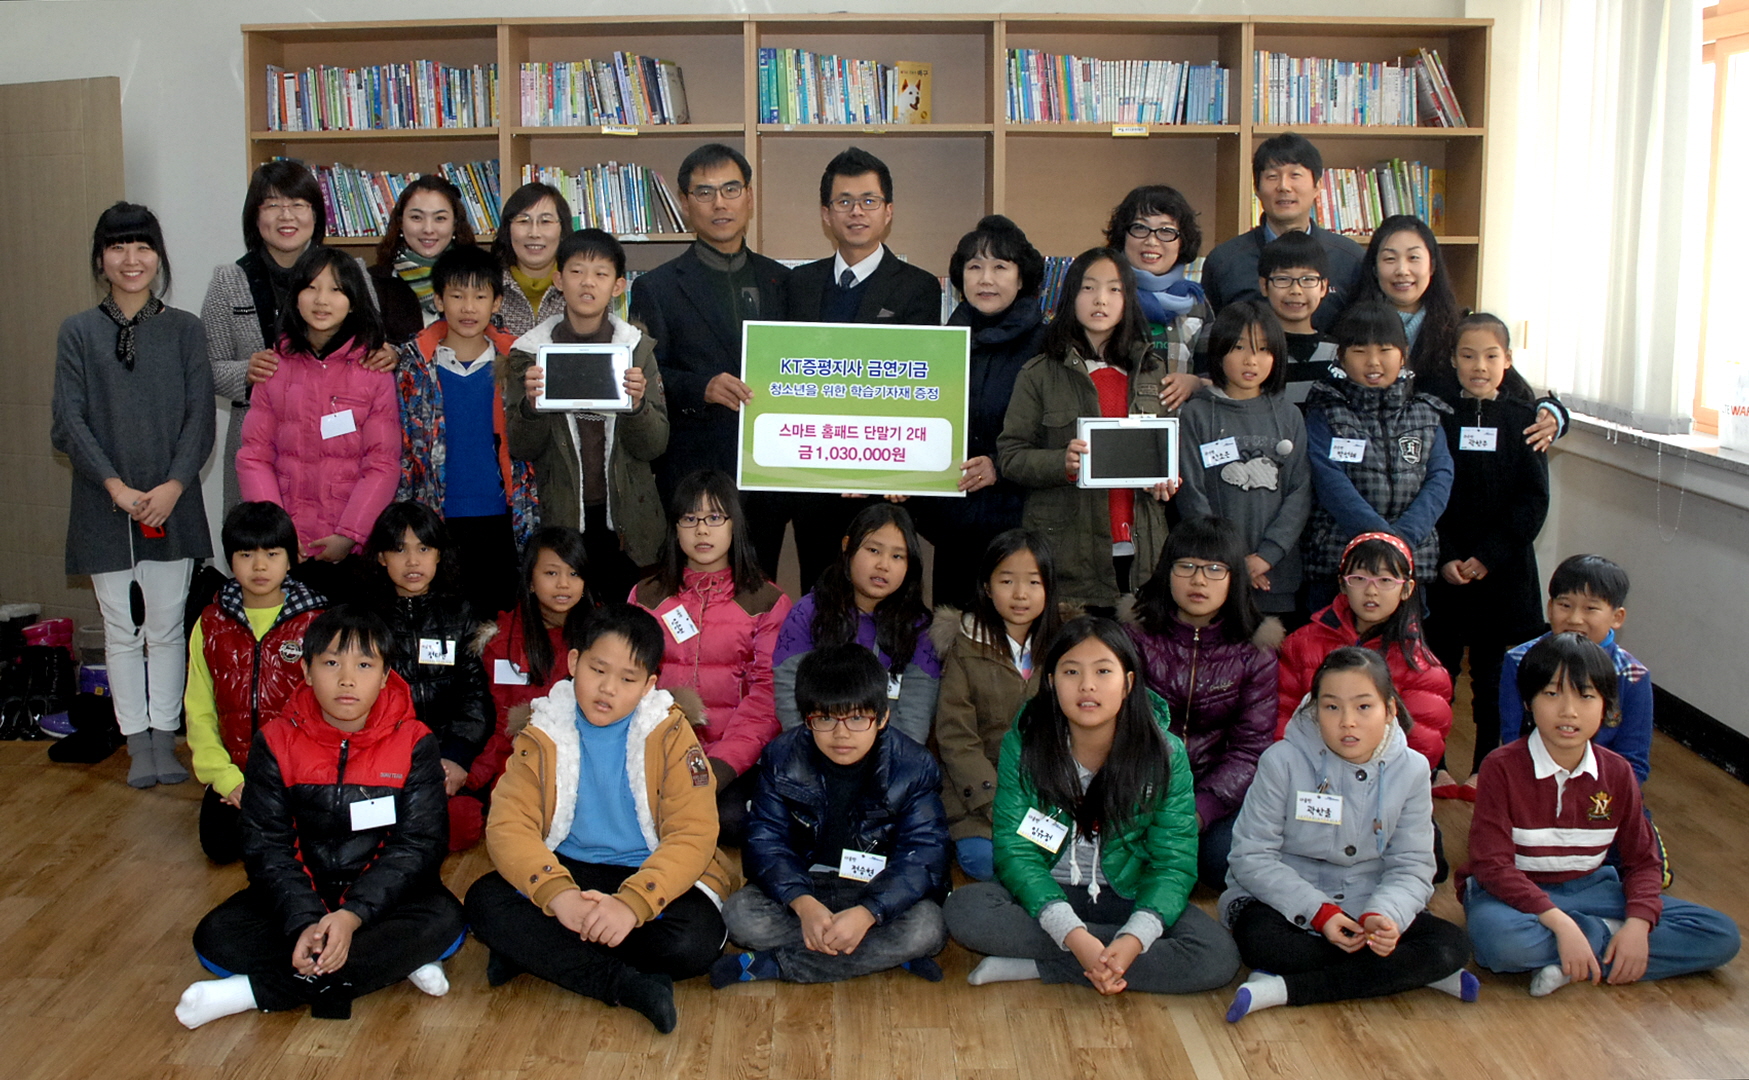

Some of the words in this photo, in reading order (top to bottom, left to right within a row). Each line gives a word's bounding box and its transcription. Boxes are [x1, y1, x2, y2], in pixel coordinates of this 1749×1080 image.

[781, 358, 862, 376] KT증평지사
[868, 360, 928, 378] 금연기금
[770, 383, 818, 397] 청소년을
[823, 385, 846, 398] 위한
[850, 385, 911, 399] 학습기자재
[914, 387, 939, 400] 증정
[779, 423, 817, 438] 스마트
[821, 423, 860, 439] 홈패드
[864, 425, 901, 441] 단말기
[906, 427, 927, 441] 2대
[798, 444, 906, 462] 금1,030,000원
[1031, 826, 1054, 842] 임유정
